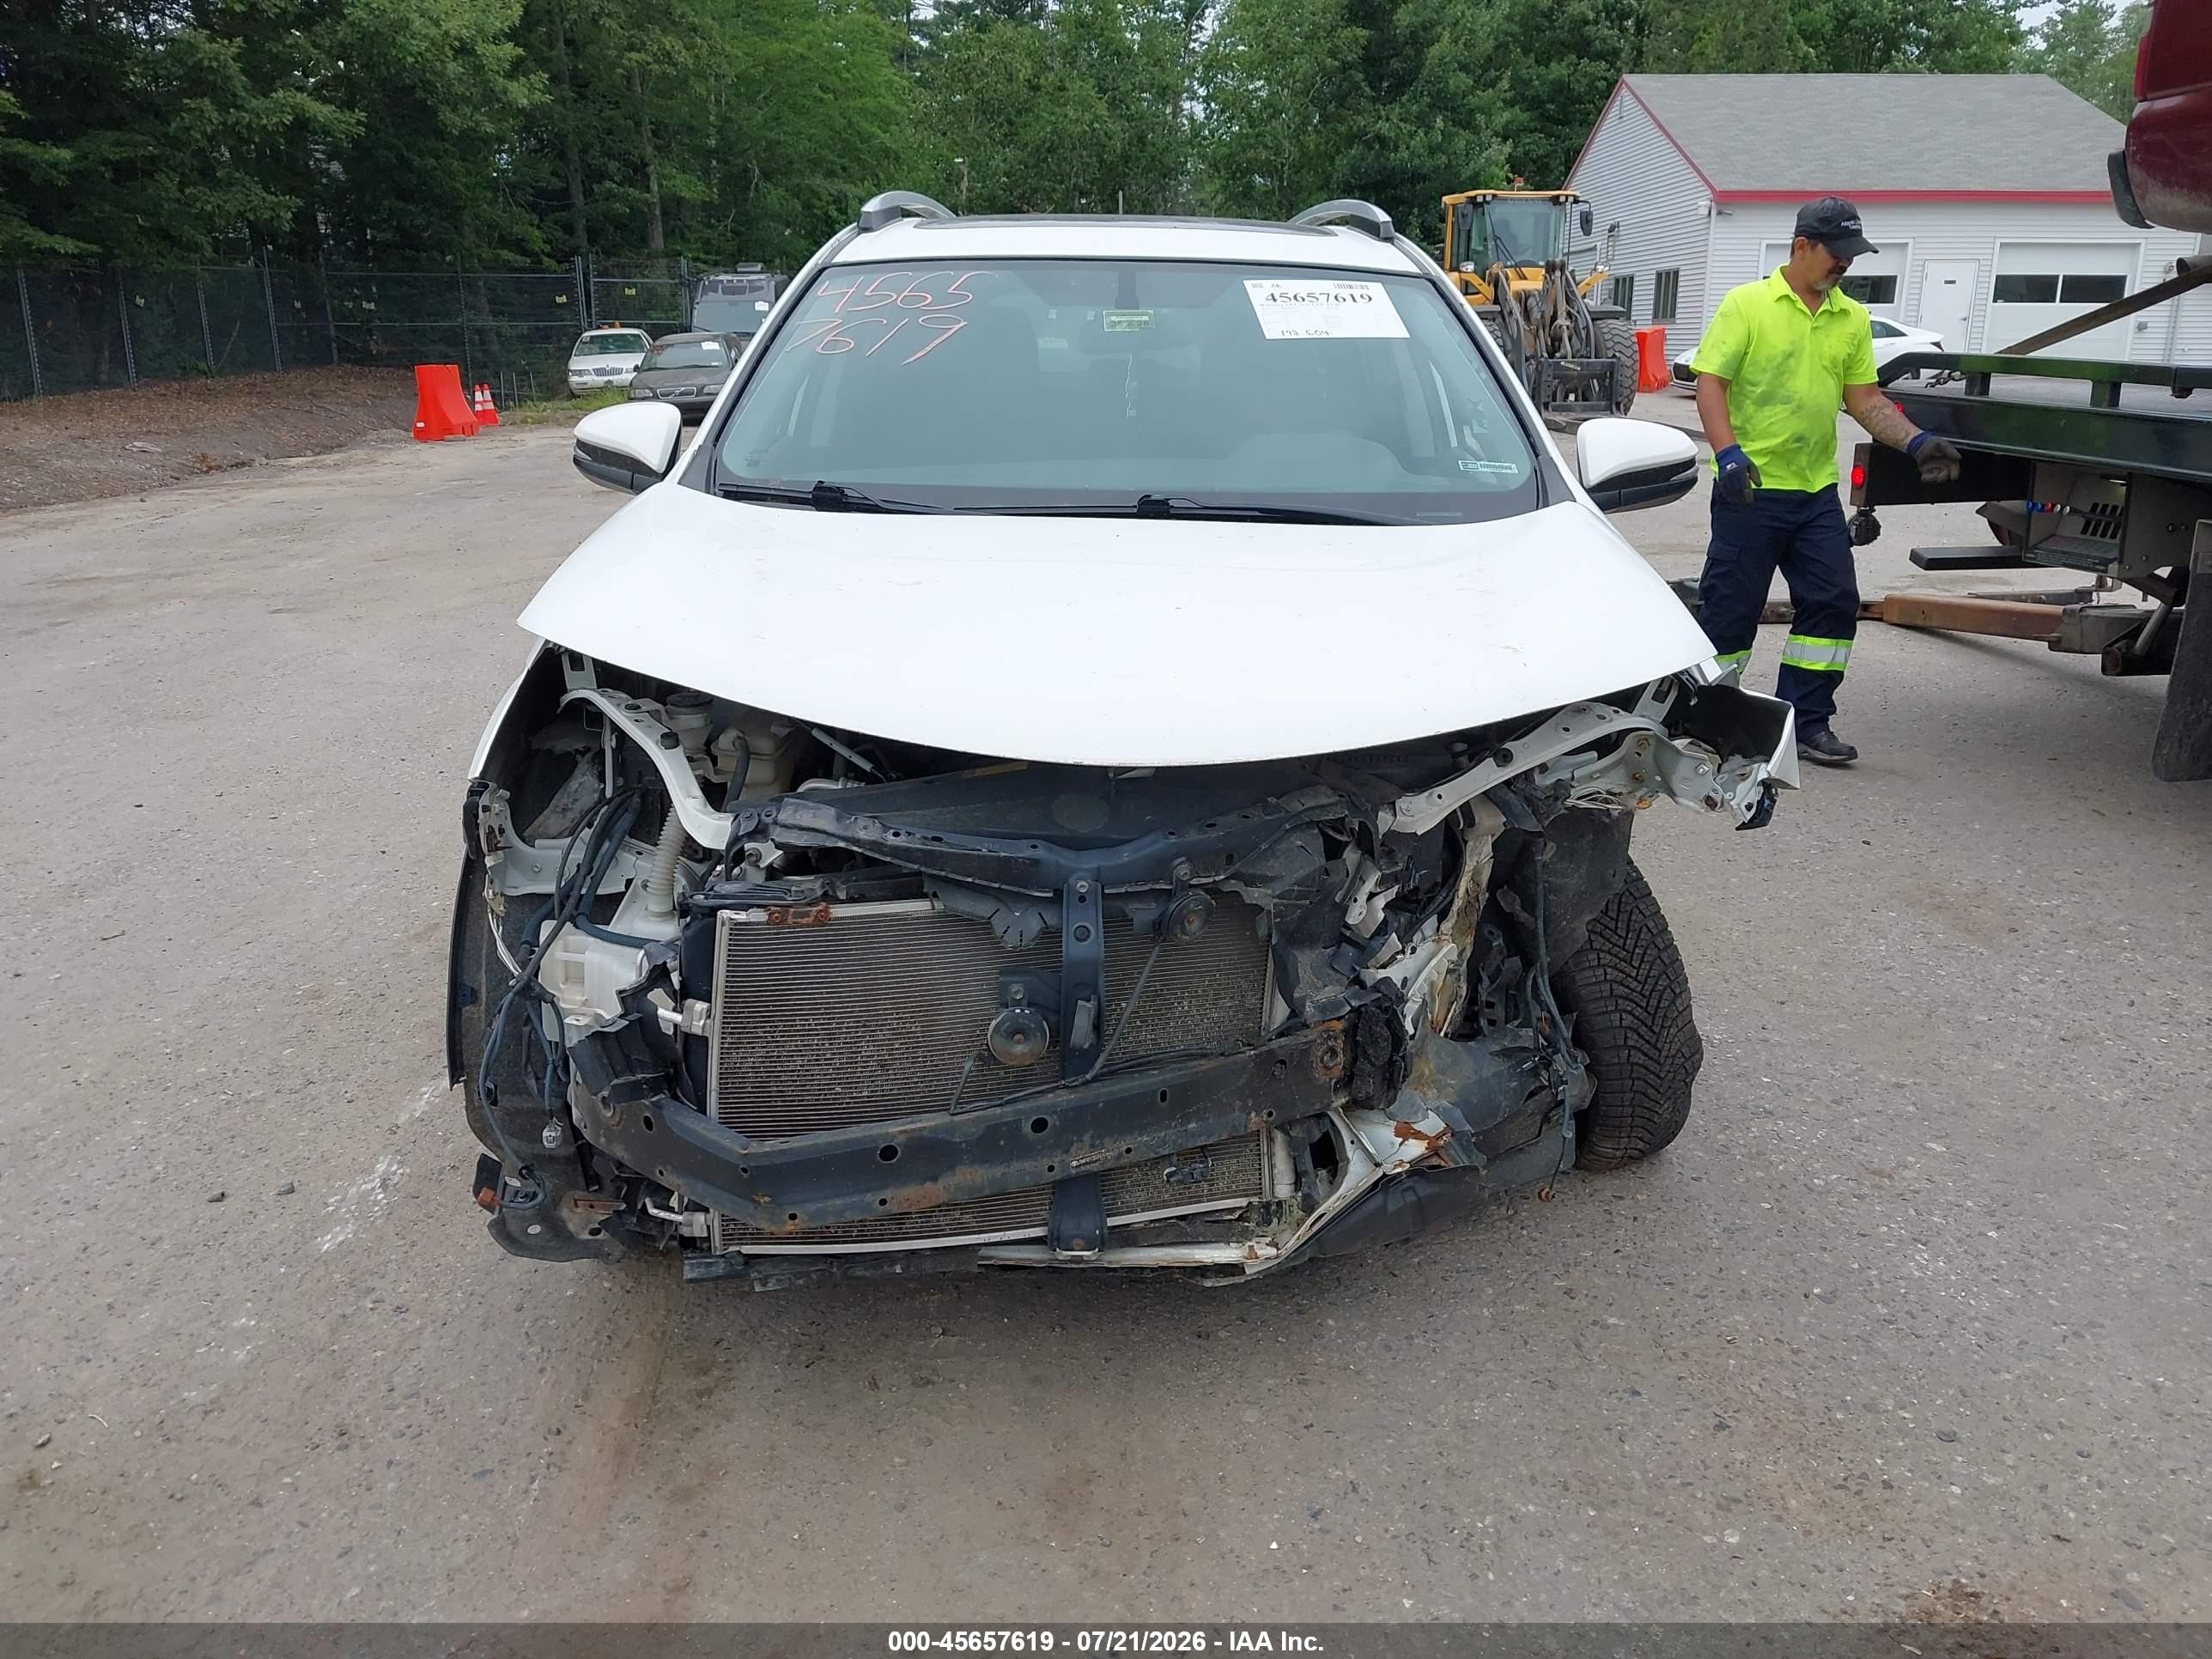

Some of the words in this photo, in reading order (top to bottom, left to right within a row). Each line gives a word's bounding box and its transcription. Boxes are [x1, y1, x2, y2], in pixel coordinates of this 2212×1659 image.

[817, 271, 999, 313] 4565
[1265, 292, 1373, 303] 45657619
[785, 313, 969, 366] 7619
